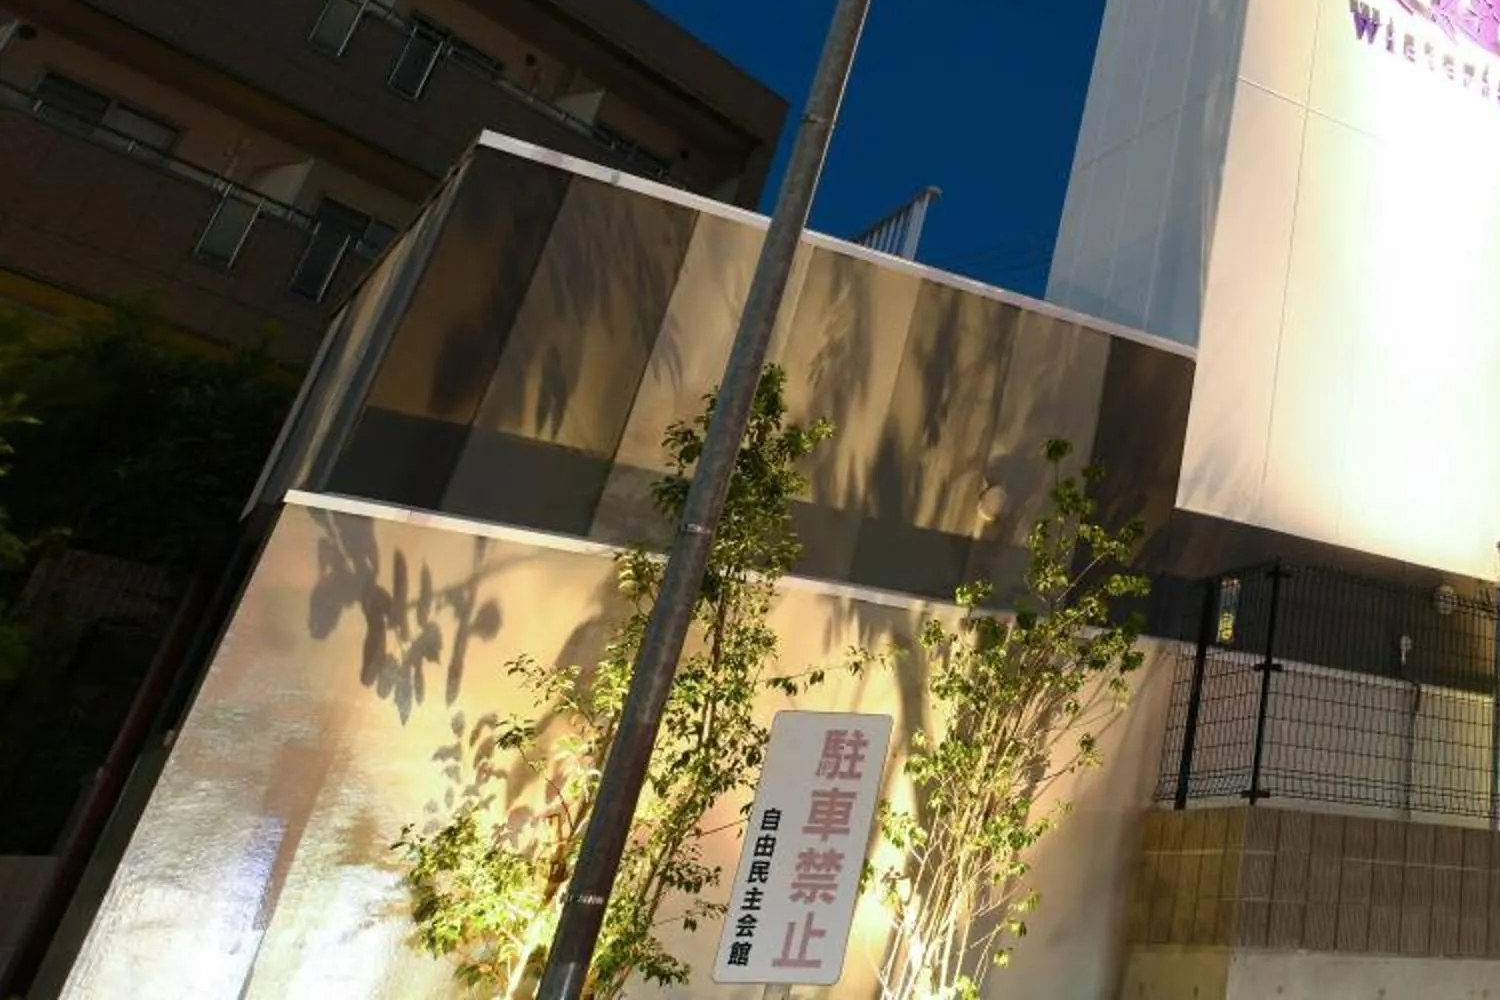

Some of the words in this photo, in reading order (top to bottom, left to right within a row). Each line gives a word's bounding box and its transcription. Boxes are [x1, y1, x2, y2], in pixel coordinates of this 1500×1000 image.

[728, 808, 782, 966] 自由民主会館
[772, 729, 868, 969] 駐車禁止
